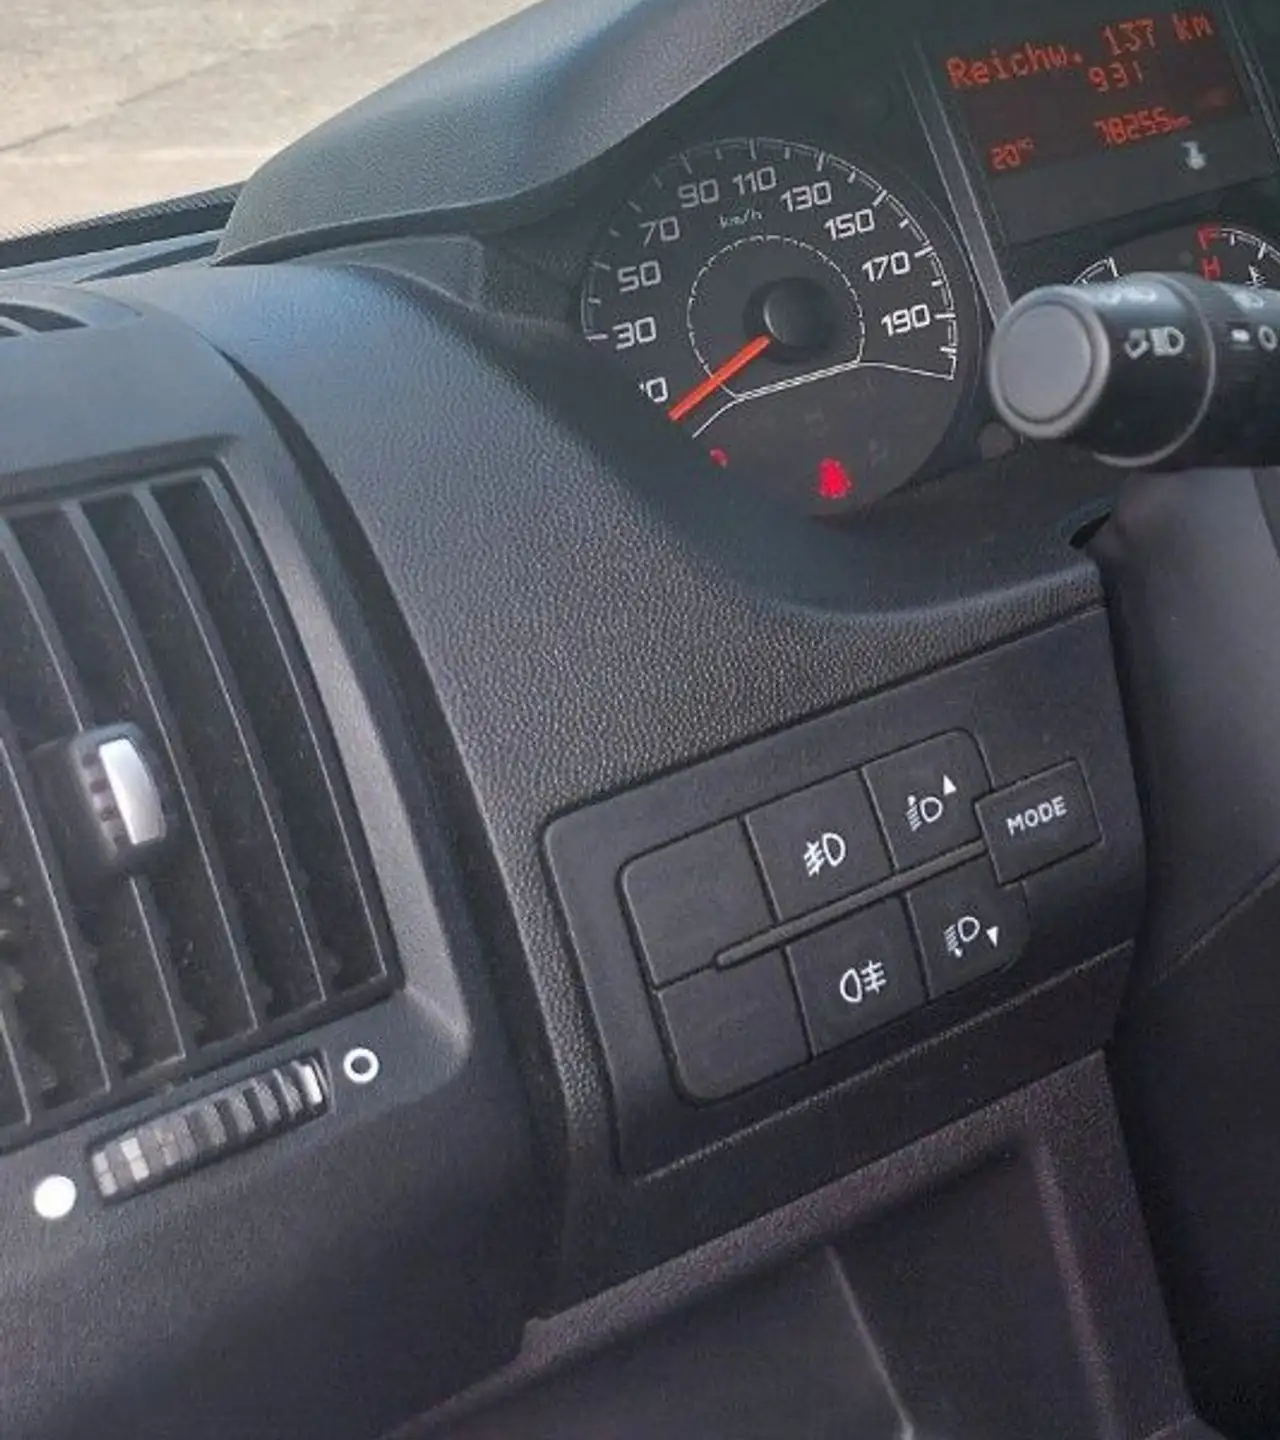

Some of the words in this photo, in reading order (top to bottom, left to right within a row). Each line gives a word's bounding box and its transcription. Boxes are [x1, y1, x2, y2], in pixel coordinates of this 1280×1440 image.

[947, 41, 1084, 89] Reichw.
[1103, 19, 1156, 56] 137
[1172, 12, 1214, 41] km
[678, 178, 720, 209] 90
[732, 165, 777, 196] 110
[780, 181, 832, 213] 130
[639, 215, 681, 246] 70
[823, 208, 876, 241] 150
[617, 260, 662, 292] 50
[861, 250, 911, 282] 170
[612, 316, 658, 350] 30
[880, 303, 930, 337] 190
[1006, 795, 1068, 837] MODE
